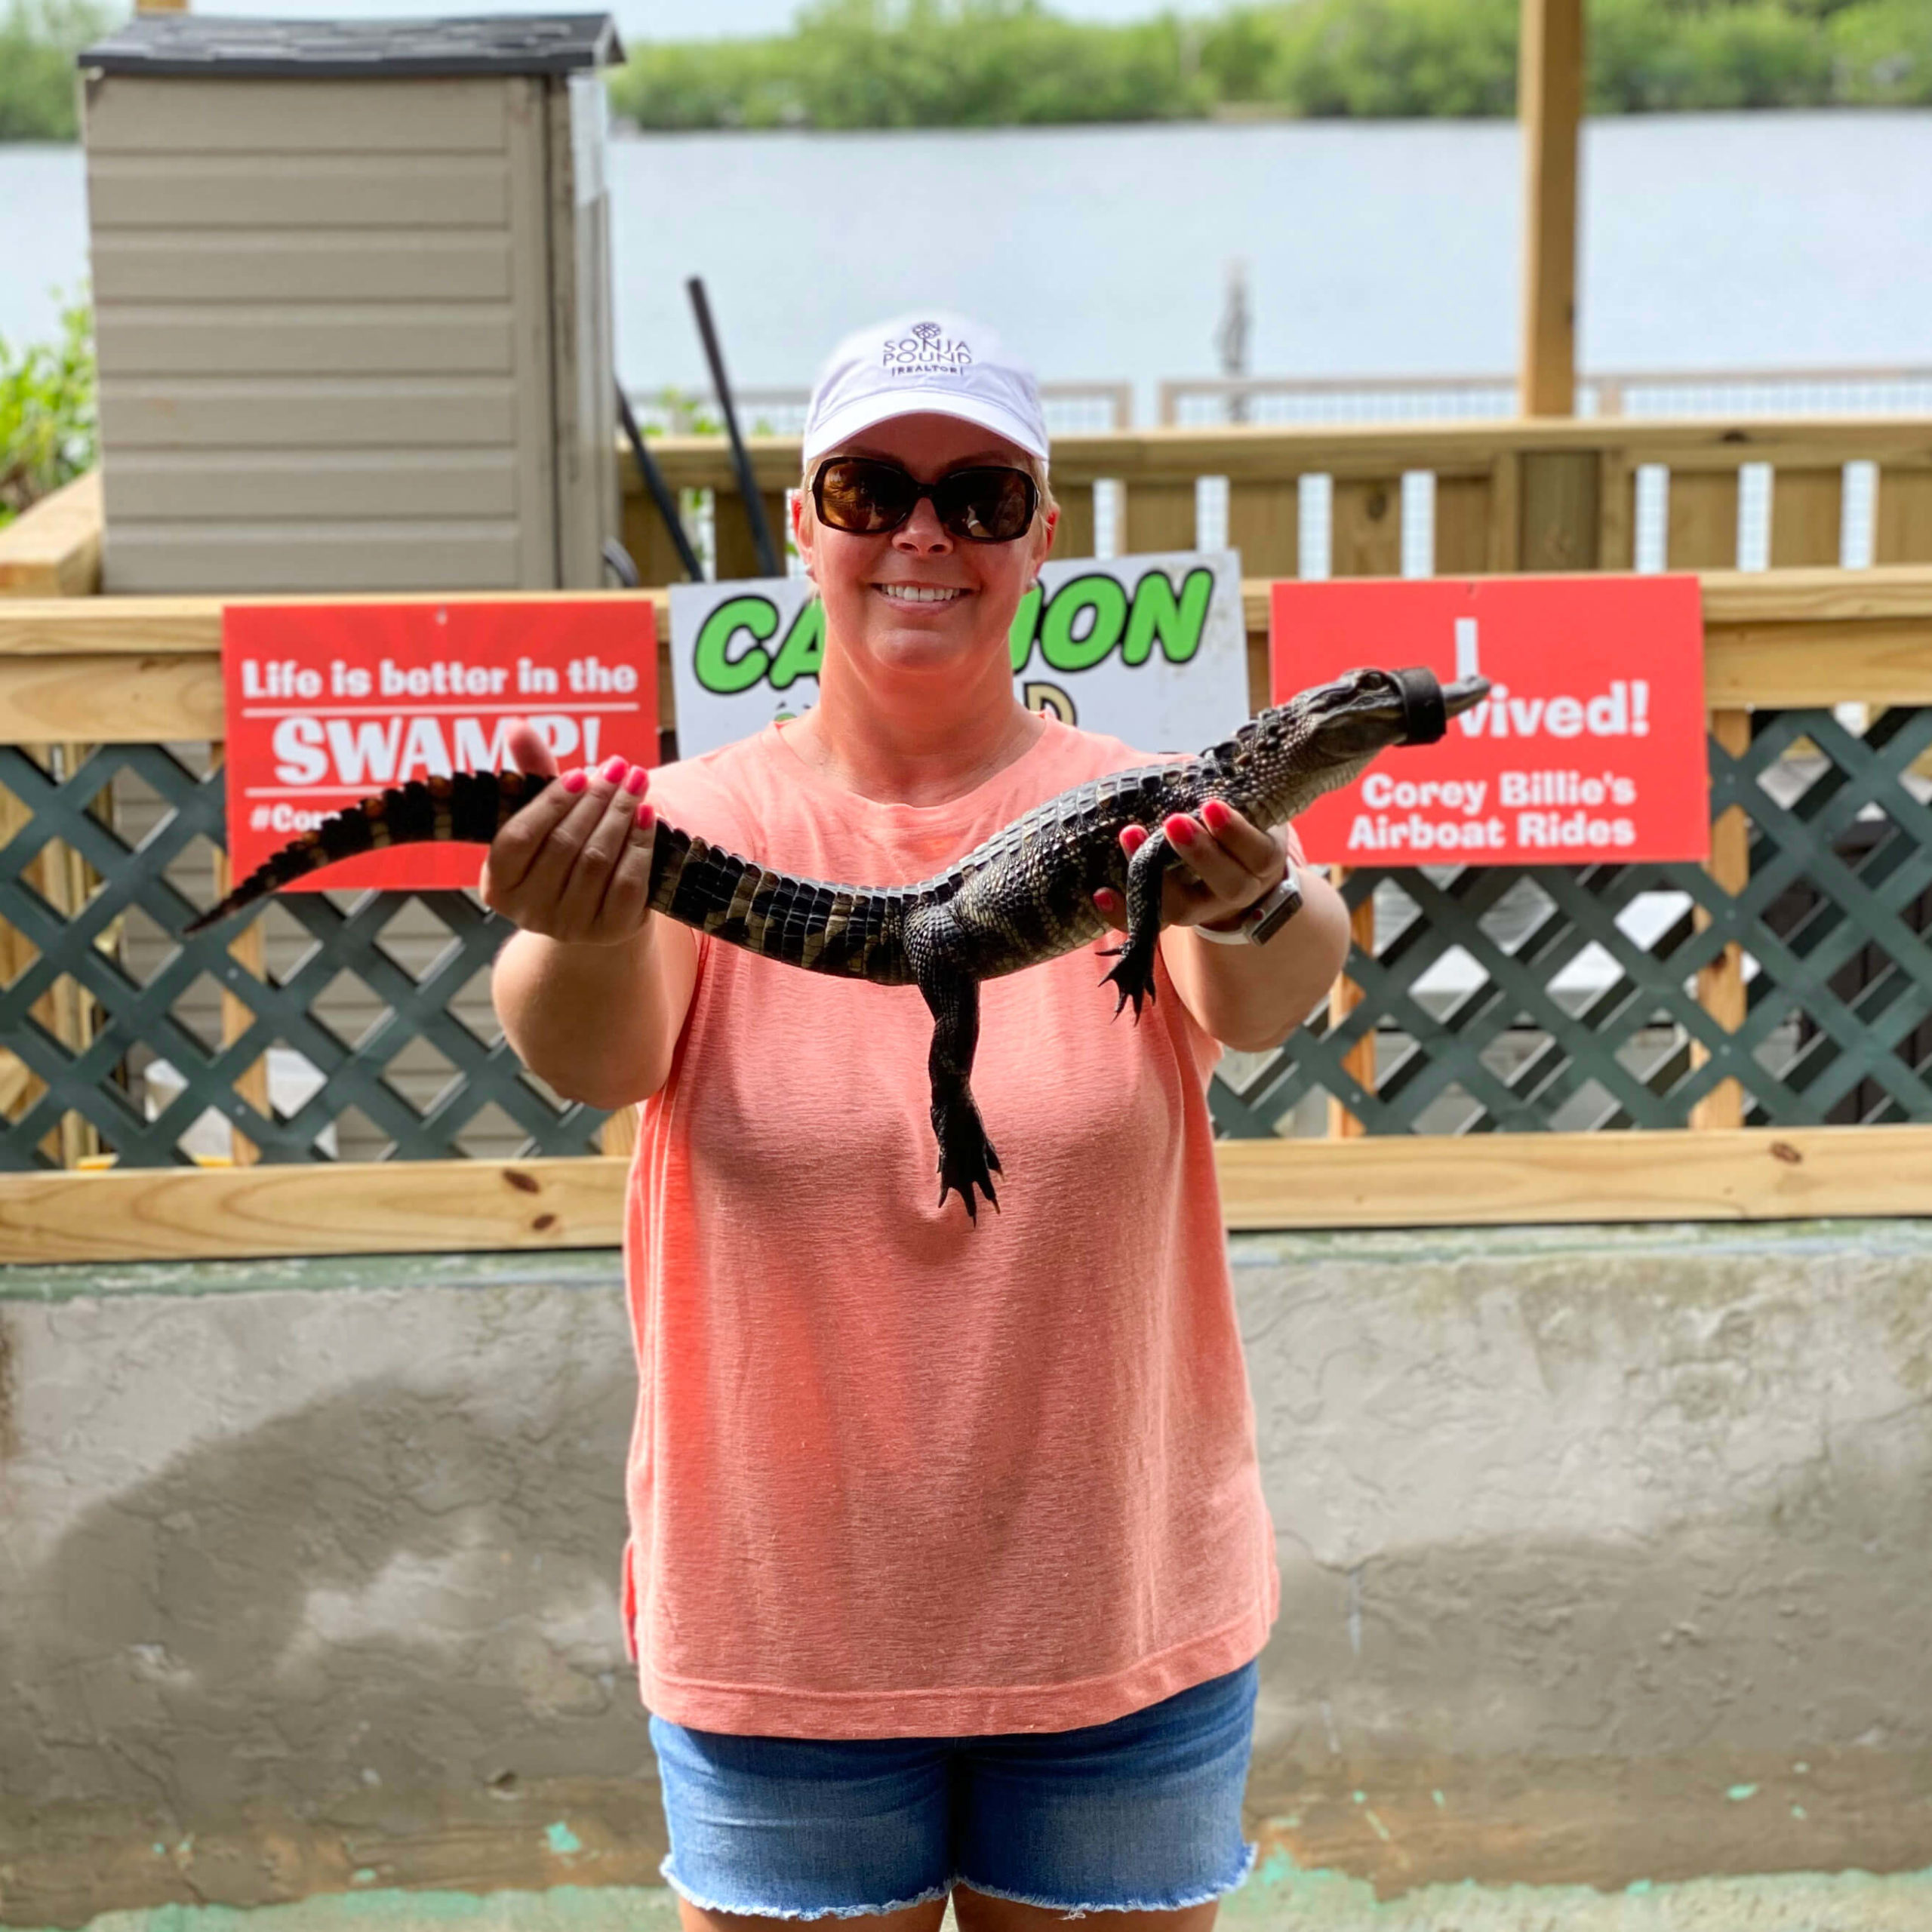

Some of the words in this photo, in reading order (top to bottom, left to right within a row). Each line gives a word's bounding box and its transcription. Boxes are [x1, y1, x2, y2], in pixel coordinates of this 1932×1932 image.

[883, 338, 971, 352] SONJA
[883, 351, 972, 366] POUND
[693, 568, 1214, 696] CAION
[1454, 617, 1479, 681] I
[242, 660, 322, 699] Life
[331, 660, 372, 697] is
[379, 659, 508, 695] better
[518, 657, 558, 694] in
[568, 656, 638, 693] the
[1457, 680, 1650, 737] vived!
[272, 714, 601, 786] SWAMP!
[1361, 773, 1487, 816] Corey
[1499, 771, 1637, 807] Billie's
[1347, 814, 1506, 850] Airboat
[1516, 811, 1637, 847] Rides
